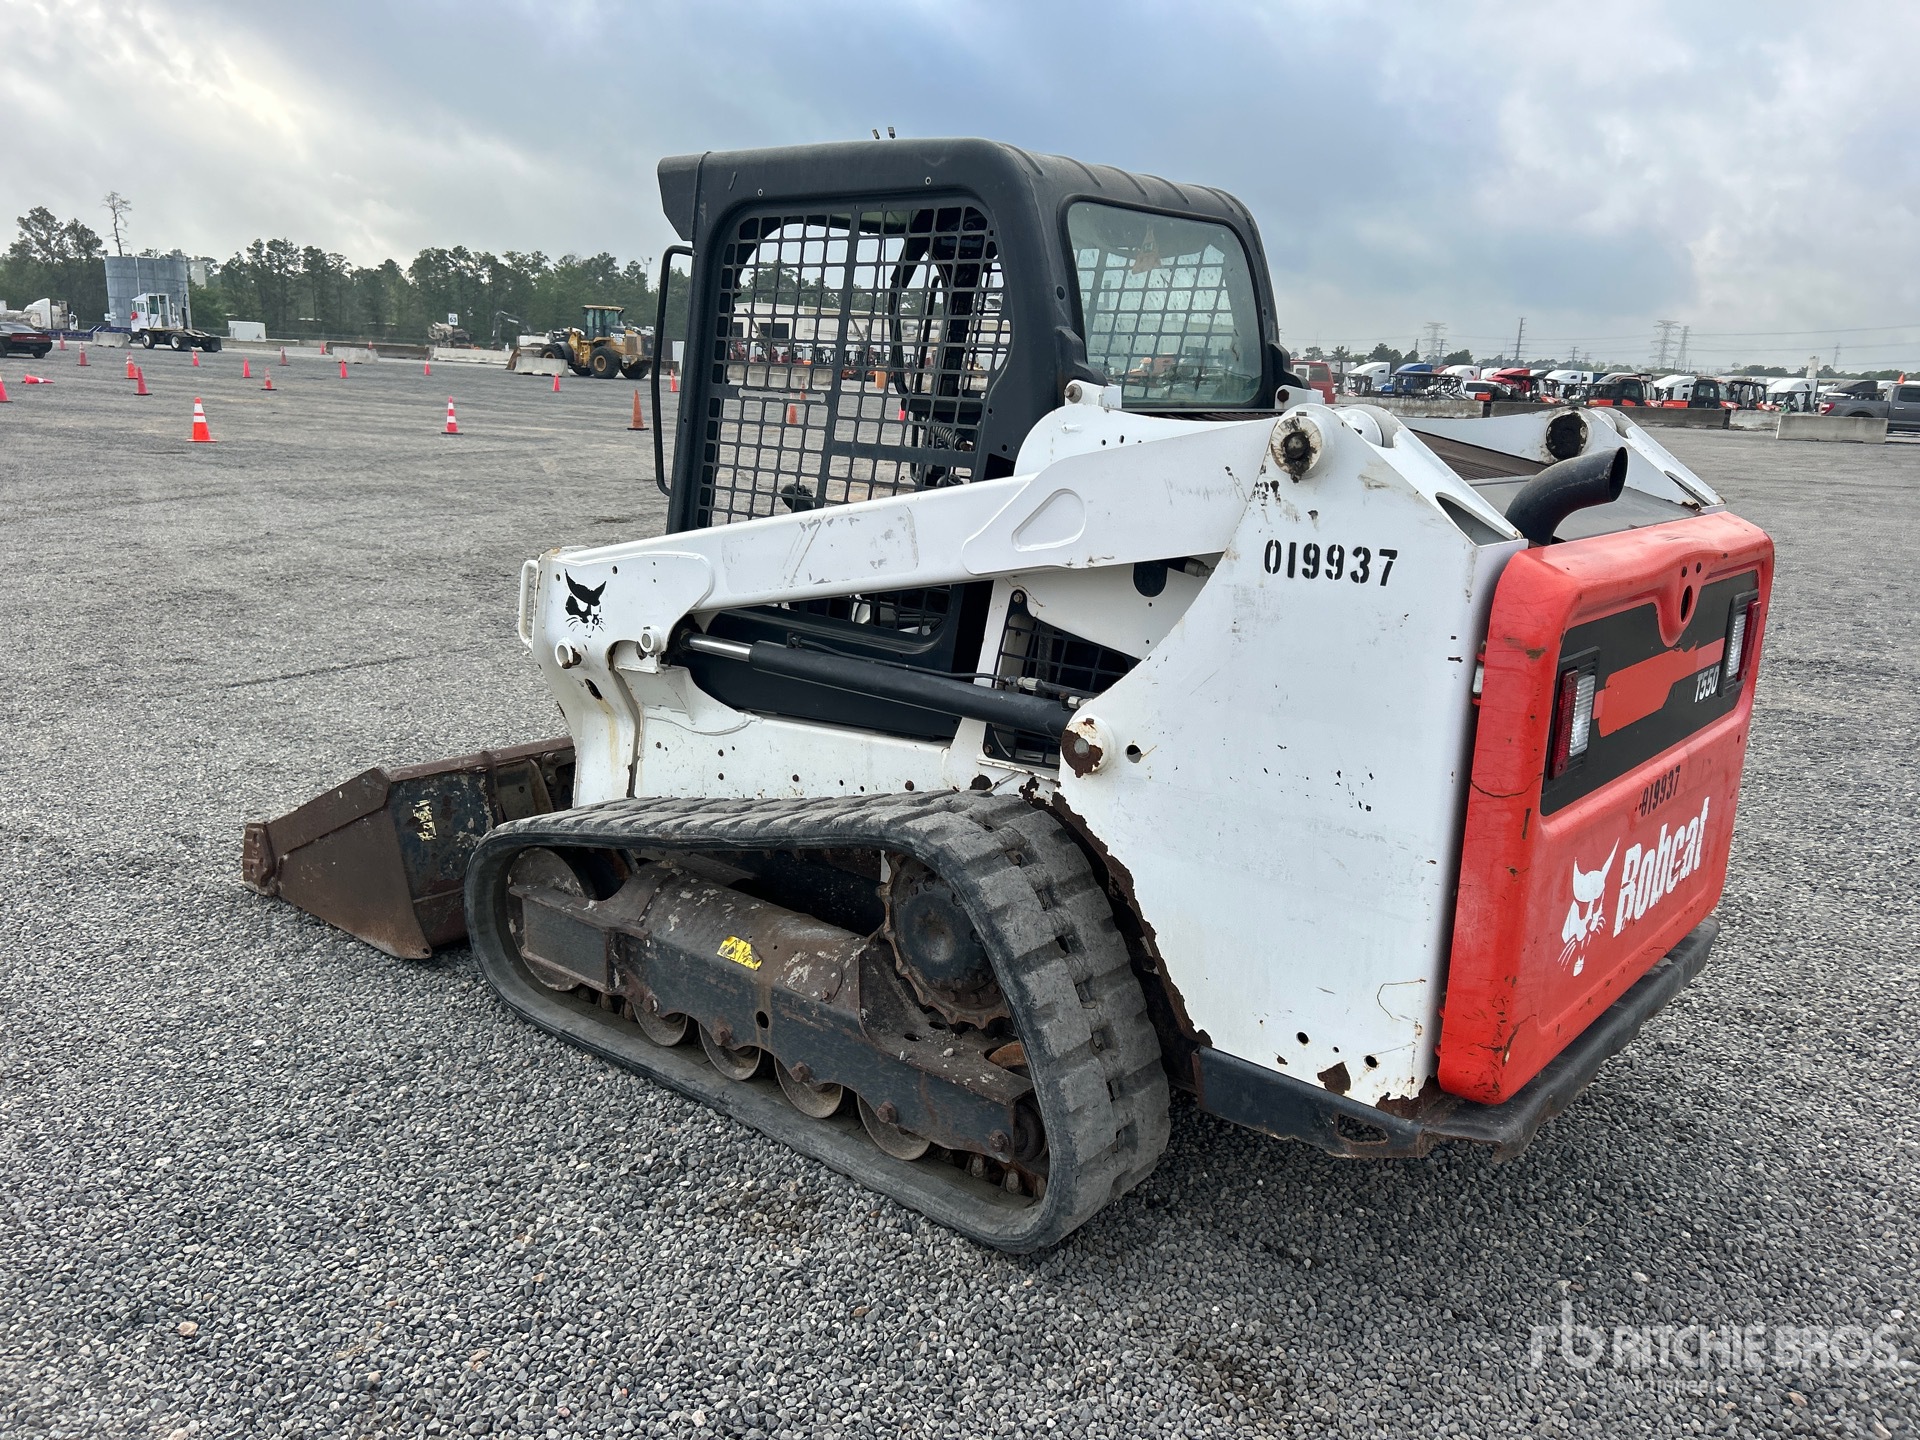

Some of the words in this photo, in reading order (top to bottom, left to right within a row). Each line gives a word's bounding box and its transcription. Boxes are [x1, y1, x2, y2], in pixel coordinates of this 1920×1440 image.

[1264, 539, 1398, 587] 019937
[1694, 665, 1720, 703] T550
[1612, 796, 1711, 939] Bobcat
